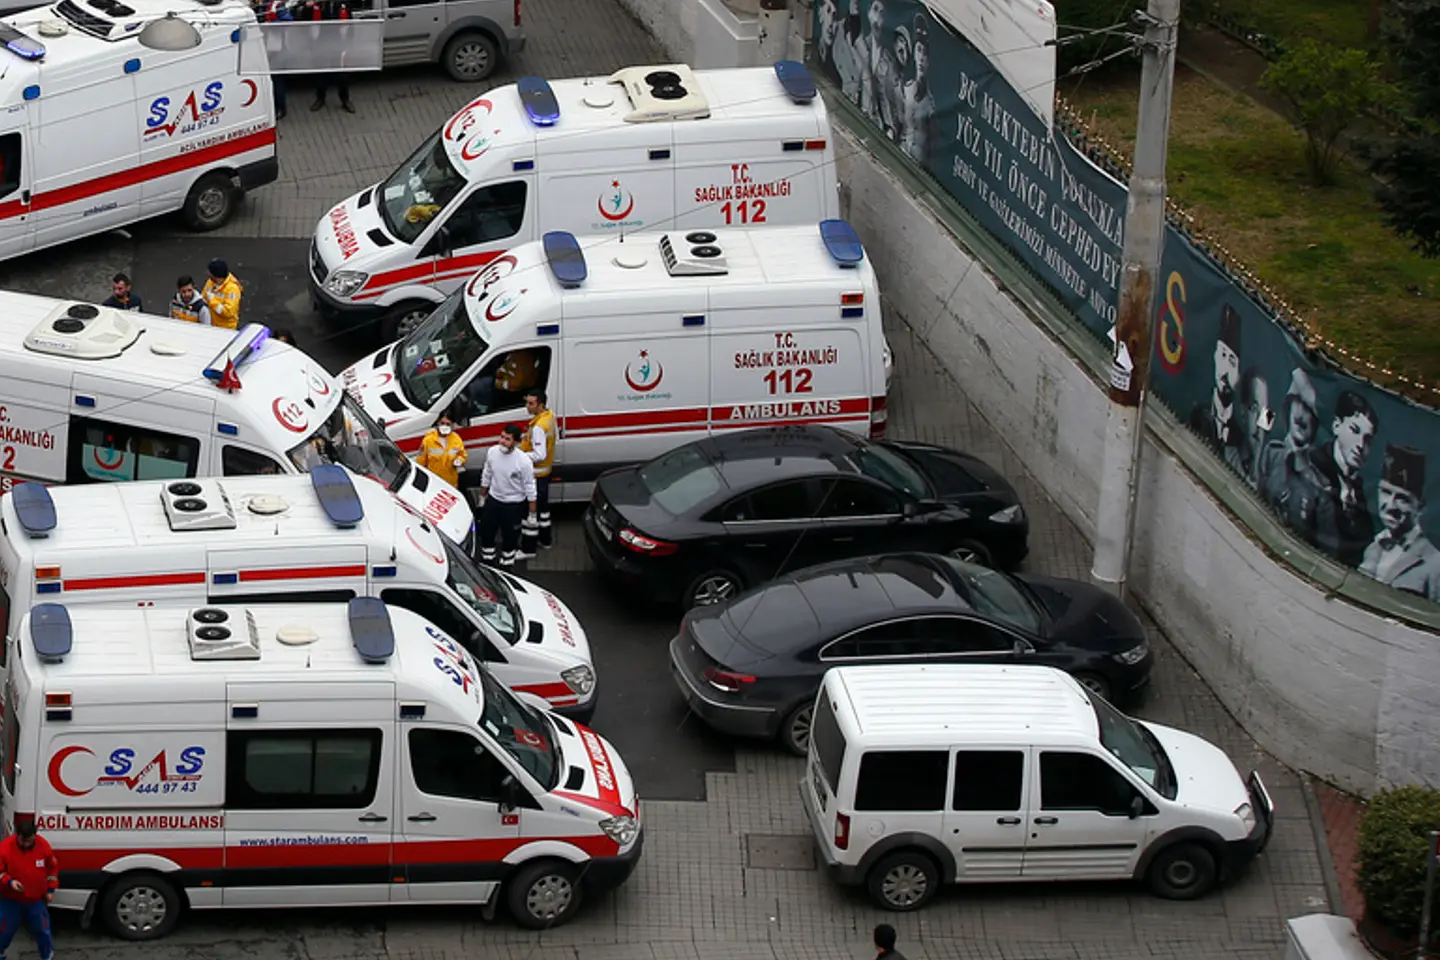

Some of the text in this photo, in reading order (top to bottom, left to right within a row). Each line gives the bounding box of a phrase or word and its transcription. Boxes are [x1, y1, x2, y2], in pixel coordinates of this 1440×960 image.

[181, 123, 197, 135] 444
[197, 120, 209, 131] 97
[981, 91, 1055, 181] MEKTEBİN
[731, 164, 752, 183] T.C.
[956, 113, 981, 157] YÜZ
[985, 139, 1003, 181] YIL
[1008, 159, 1048, 219] ÖNCE
[695, 178, 791, 202] SAĞLIK BAKANLIĞI
[720, 200, 767, 225] 112
[775, 333, 797, 348] T.C.
[734, 345, 838, 368] SAĞLIK BAKANLIĞI
[763, 369, 813, 394] 112
[283, 401, 304, 423] 112
[729, 401, 842, 420] AMBULANS
[136, 782, 198, 795] 444 97 43
[76, 815, 134, 830] YARDIM
[135, 814, 225, 830] AMBULANSI
